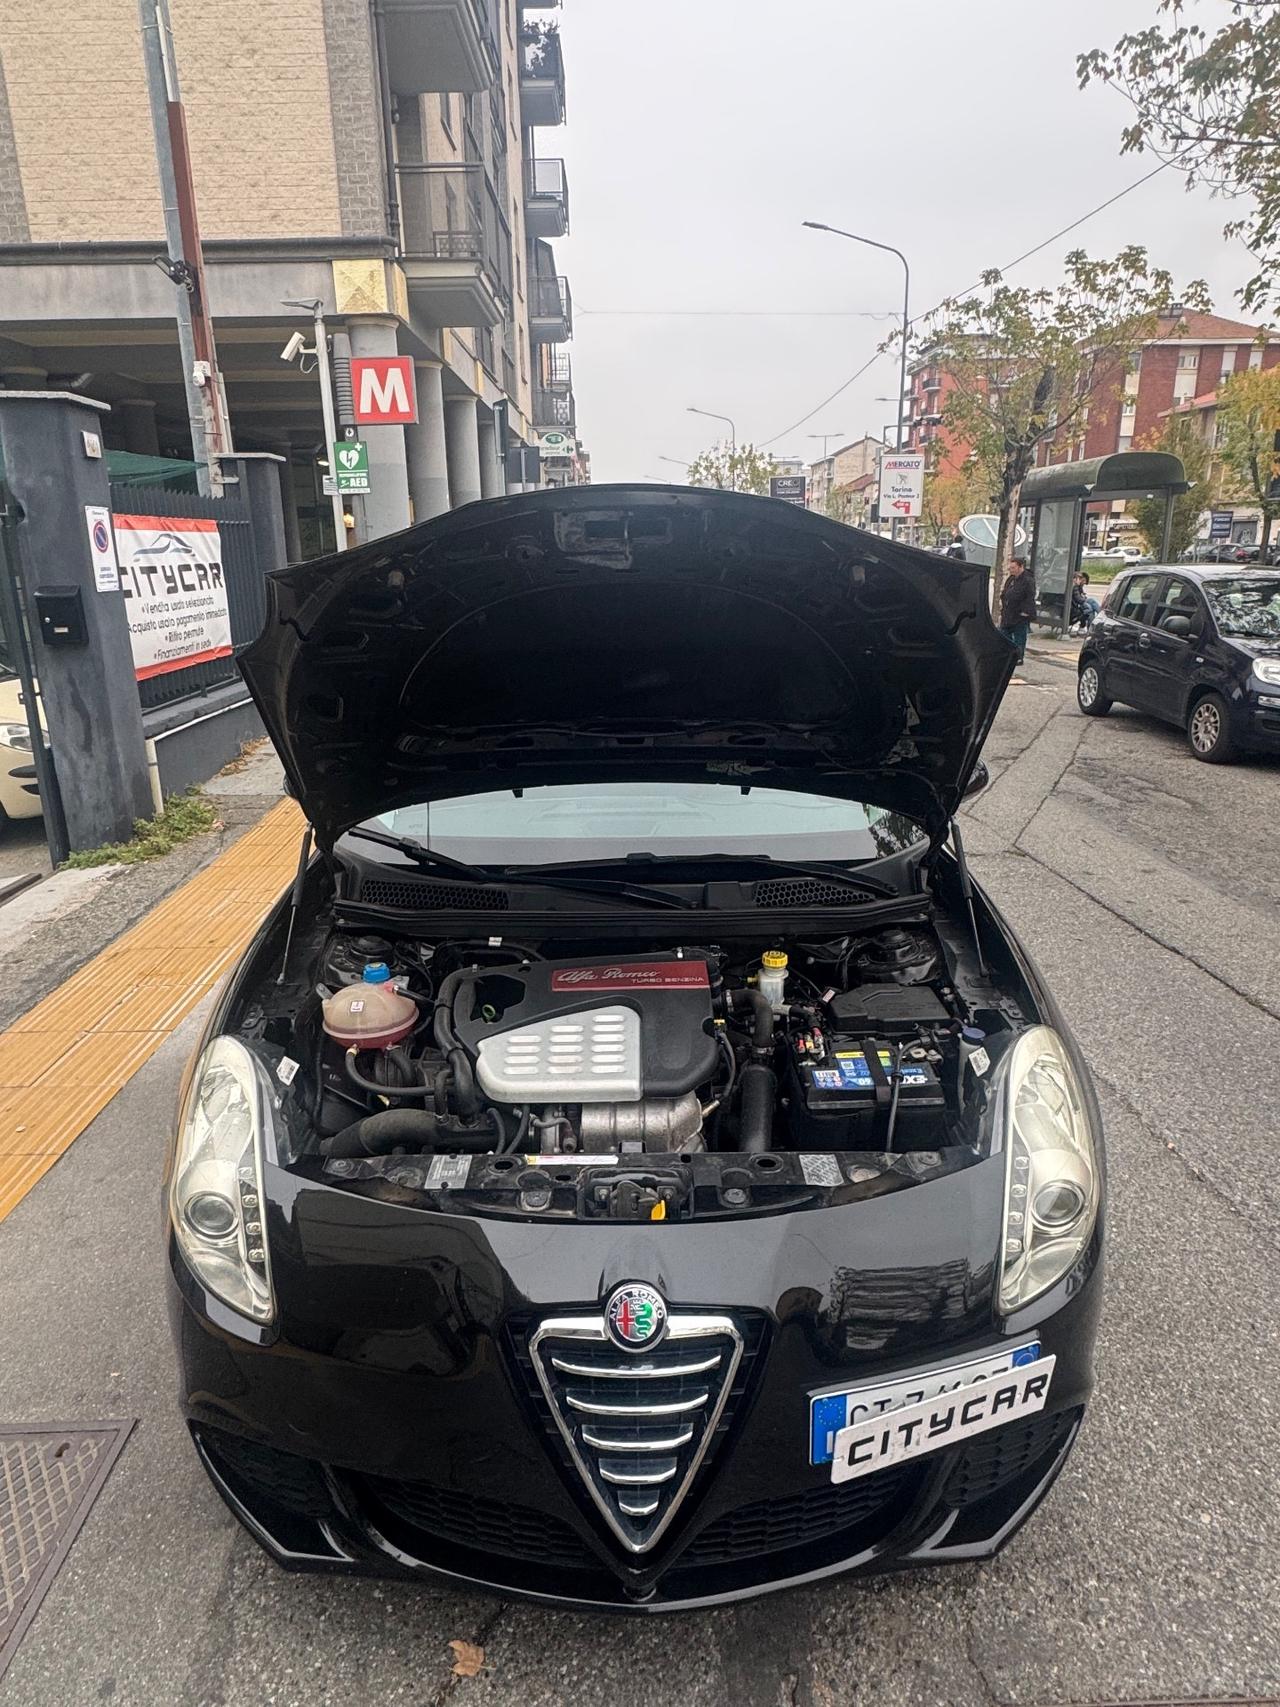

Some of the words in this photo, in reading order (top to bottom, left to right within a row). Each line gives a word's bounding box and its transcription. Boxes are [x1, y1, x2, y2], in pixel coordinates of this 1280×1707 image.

[360, 367, 411, 413] M
[350, 477, 367, 487] AED
[119, 563, 223, 598] CITYCAR
[158, 617, 175, 630] usato
[176, 612, 206, 627] pagamento
[557, 970, 598, 984] Alfa
[602, 967, 660, 979] Romeo
[609, 1294, 629, 1321] ALFA
[632, 1290, 664, 1319] ROMEO
[848, 1373, 1048, 1466] CITYCAR
